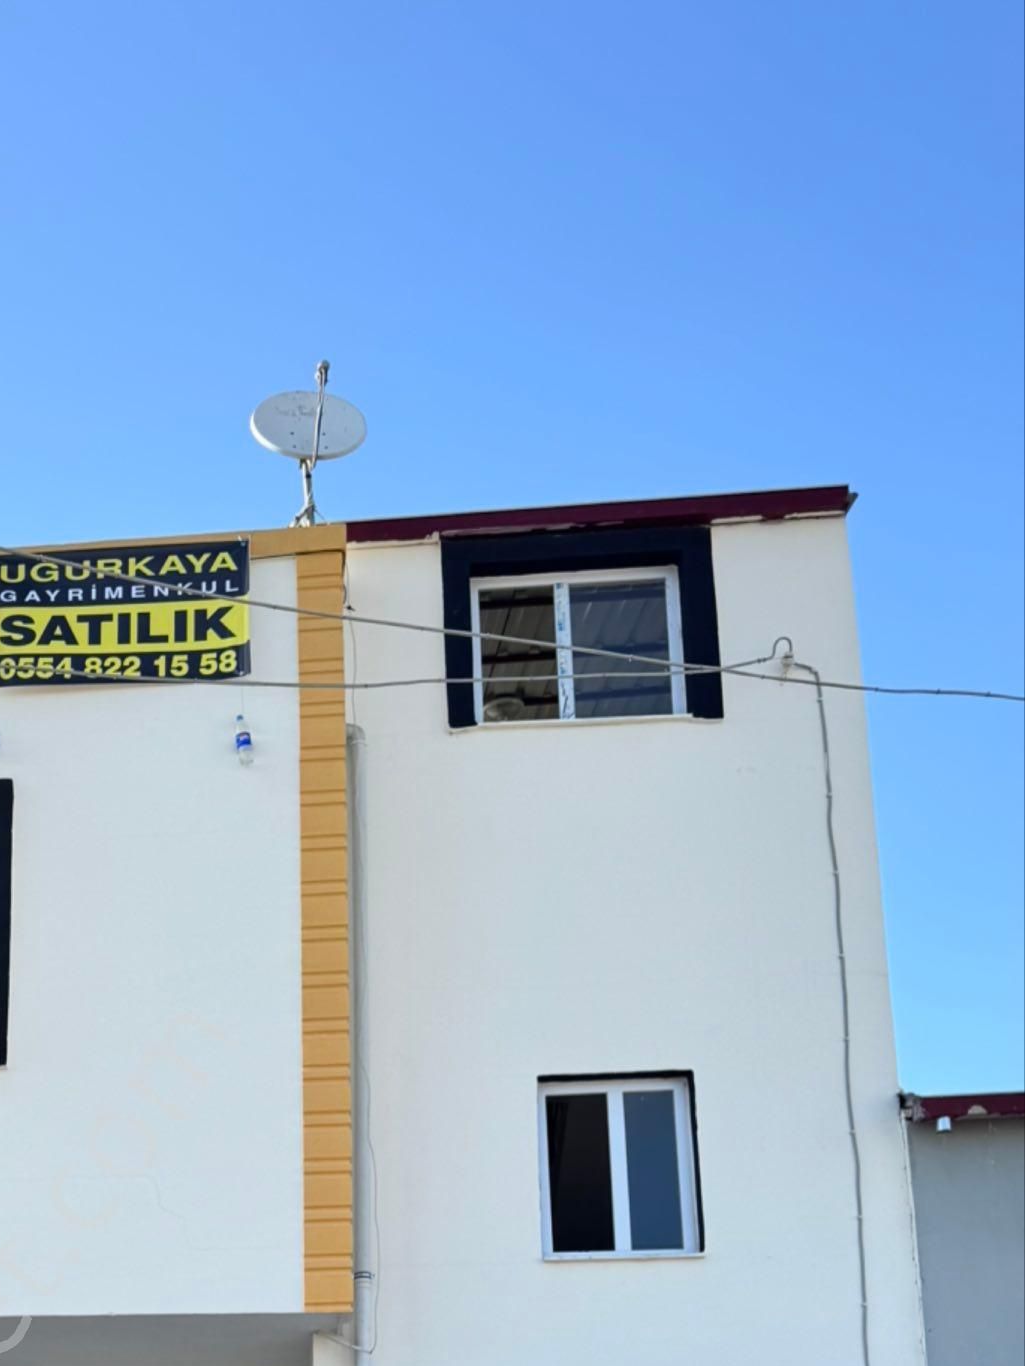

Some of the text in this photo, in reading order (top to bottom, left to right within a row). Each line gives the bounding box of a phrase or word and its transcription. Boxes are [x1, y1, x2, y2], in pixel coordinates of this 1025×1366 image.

[84, 655, 141, 679] 822
[153, 654, 189, 677] 15
[199, 649, 237, 676] 58
